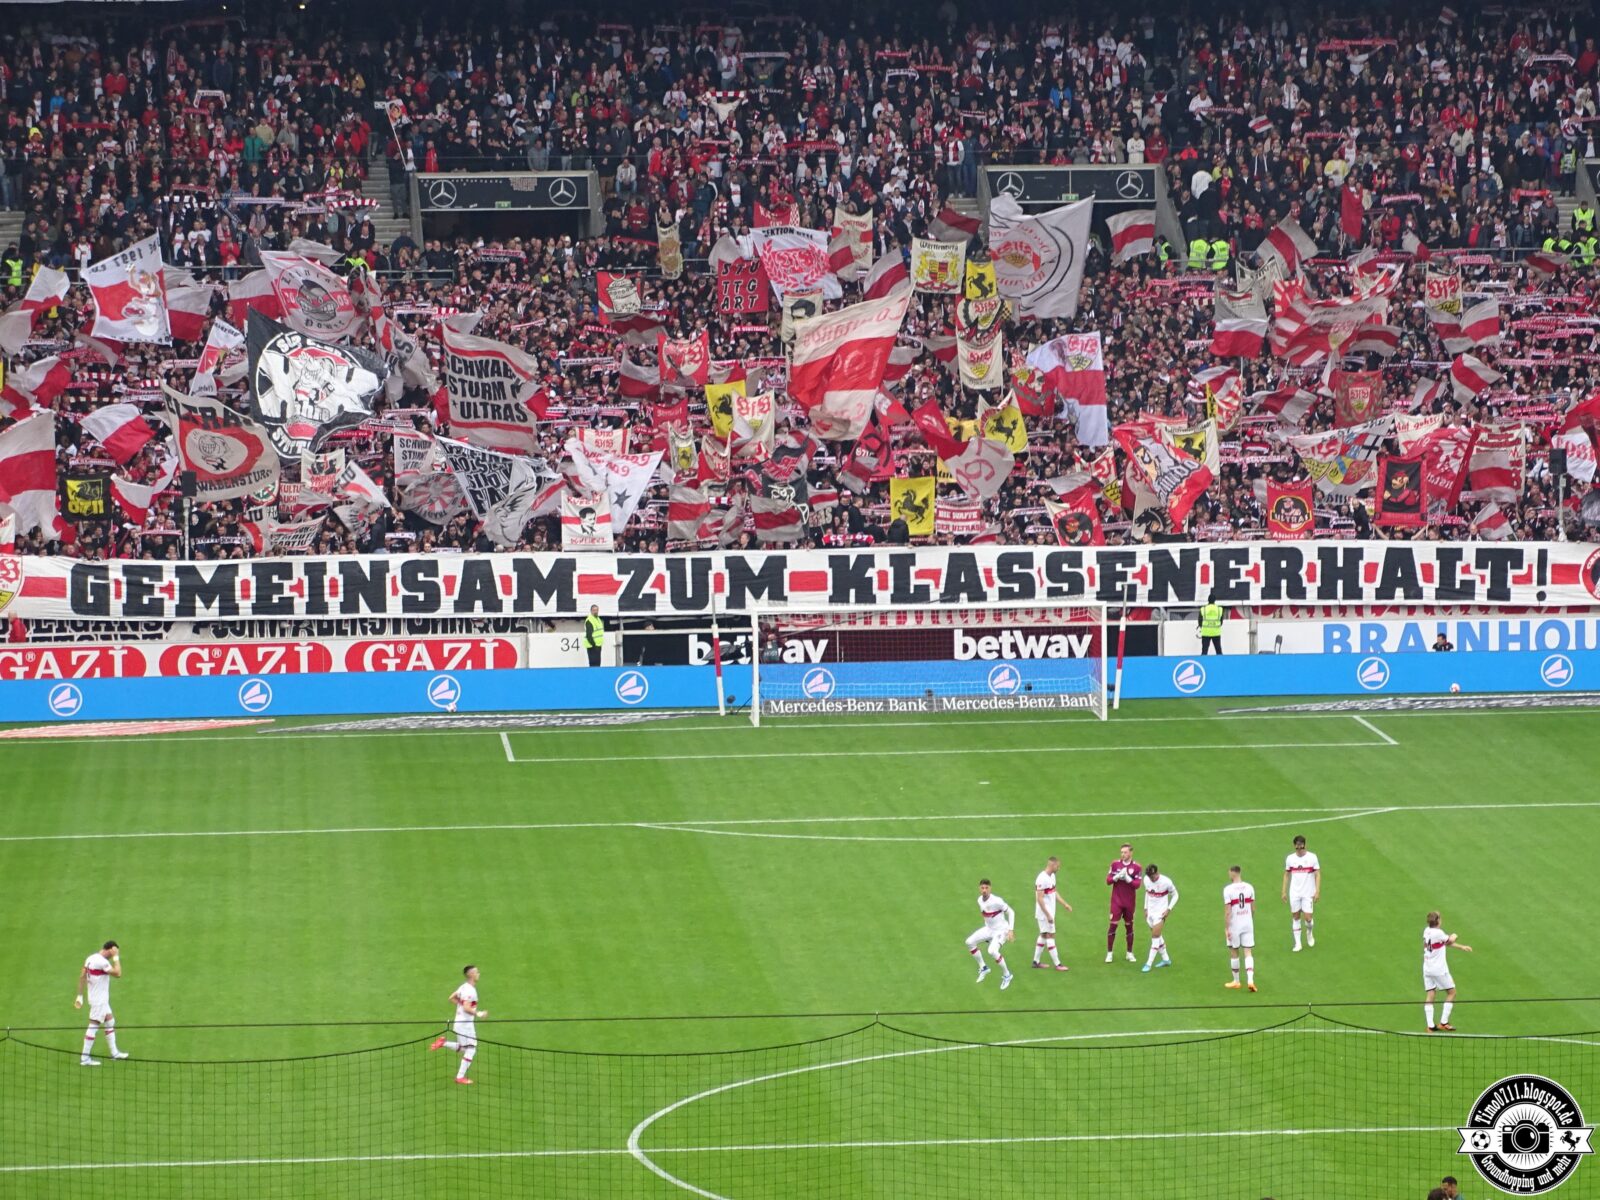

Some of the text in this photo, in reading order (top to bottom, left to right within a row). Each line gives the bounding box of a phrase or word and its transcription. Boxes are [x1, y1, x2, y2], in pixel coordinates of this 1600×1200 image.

[460, 401, 529, 423] ULTRAS
[71, 547, 1548, 618] GEMEINSAM ZUM KLASSENERHALT!
[560, 637, 580, 652] 34
[688, 633, 829, 666] bay
[953, 628, 1093, 661] betway
[770, 698, 928, 714] Mercedes-Benz Bank
[942, 693, 1100, 711] Mercedes-Benz Bank
[1238, 892, 1246, 909] 9
